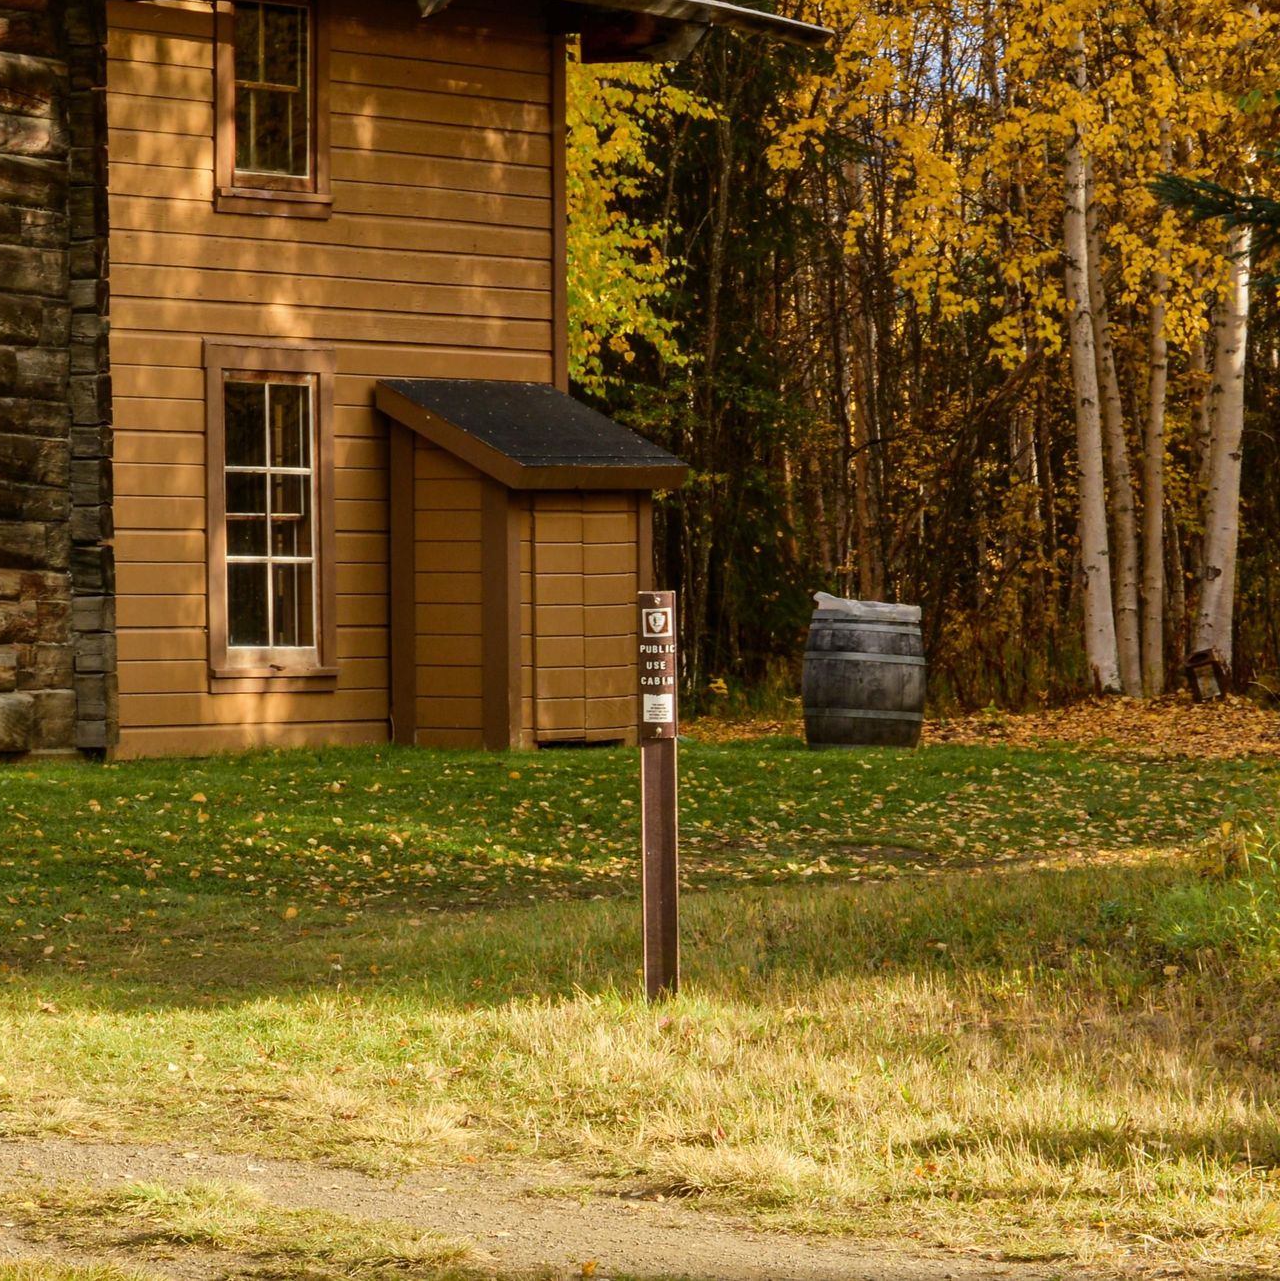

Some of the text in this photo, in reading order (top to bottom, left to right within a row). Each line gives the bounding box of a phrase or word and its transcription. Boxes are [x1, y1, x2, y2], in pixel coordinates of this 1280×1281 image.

[640, 644, 676, 653] PUBLIC
[646, 661, 666, 669] USE
[640, 677, 674, 685] CABIN
